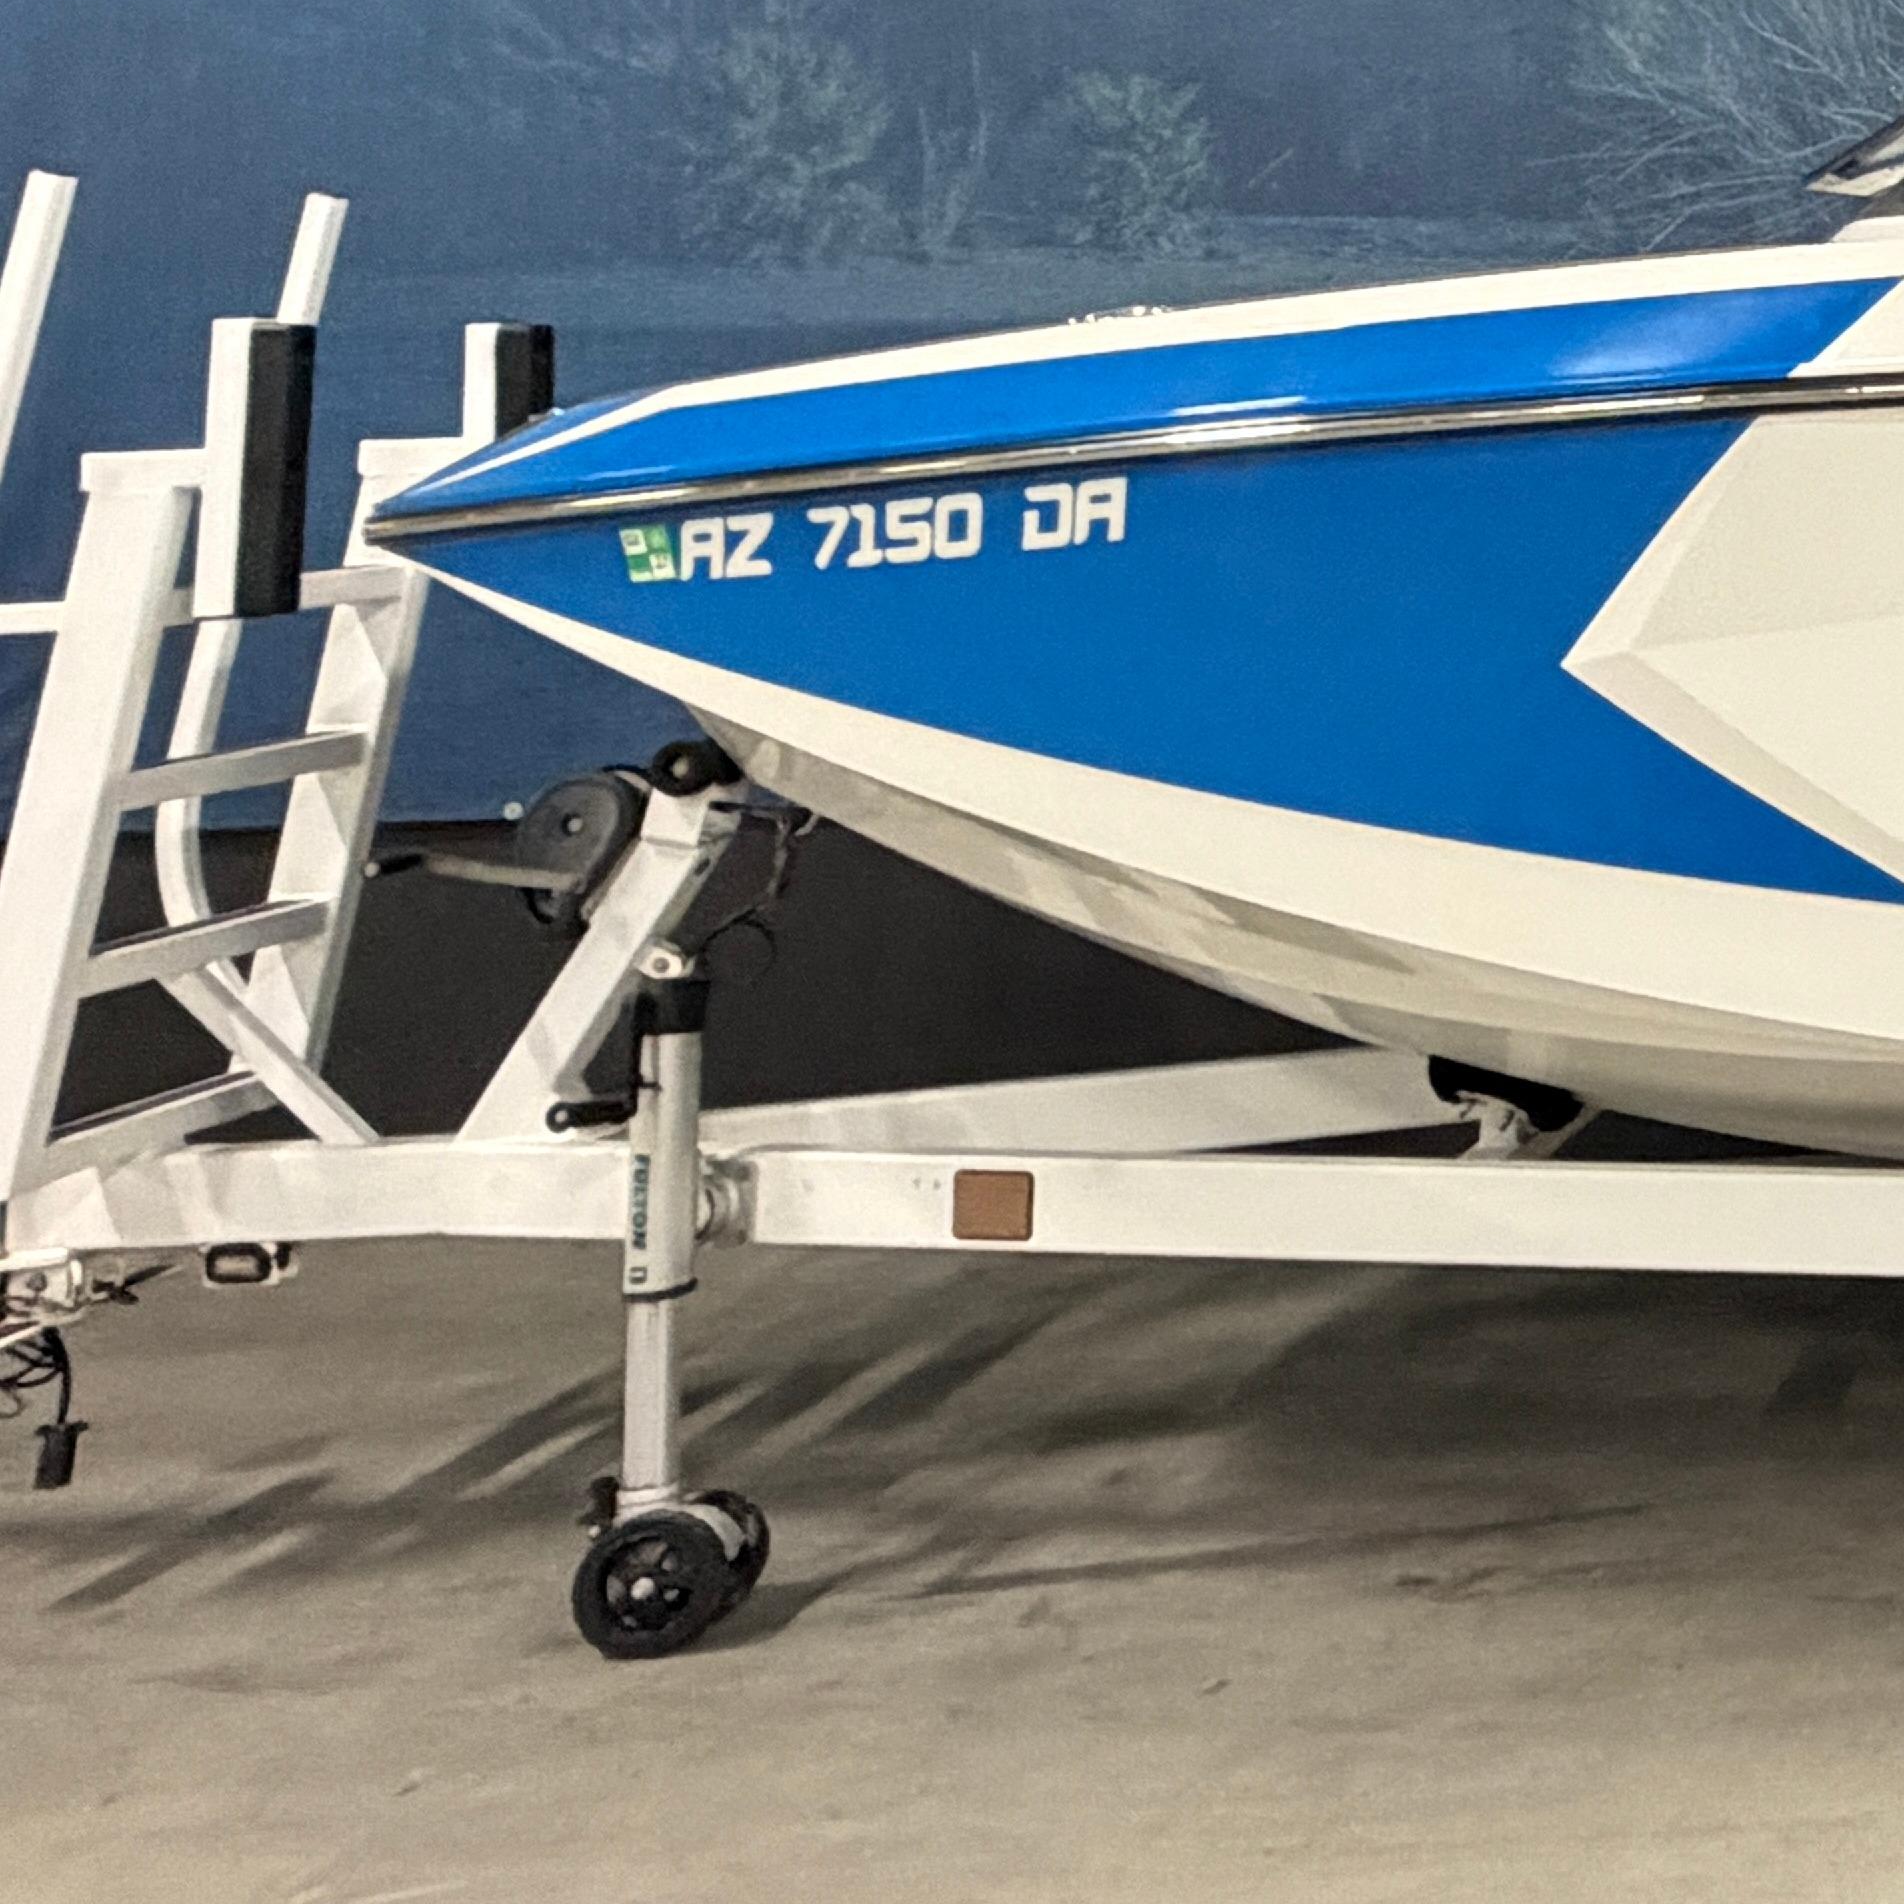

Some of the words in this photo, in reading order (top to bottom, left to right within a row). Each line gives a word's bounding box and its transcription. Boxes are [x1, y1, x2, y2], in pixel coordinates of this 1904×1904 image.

[680, 511, 775, 584] AZ
[805, 491, 985, 571] 7150
[1020, 475, 1129, 552] DA
